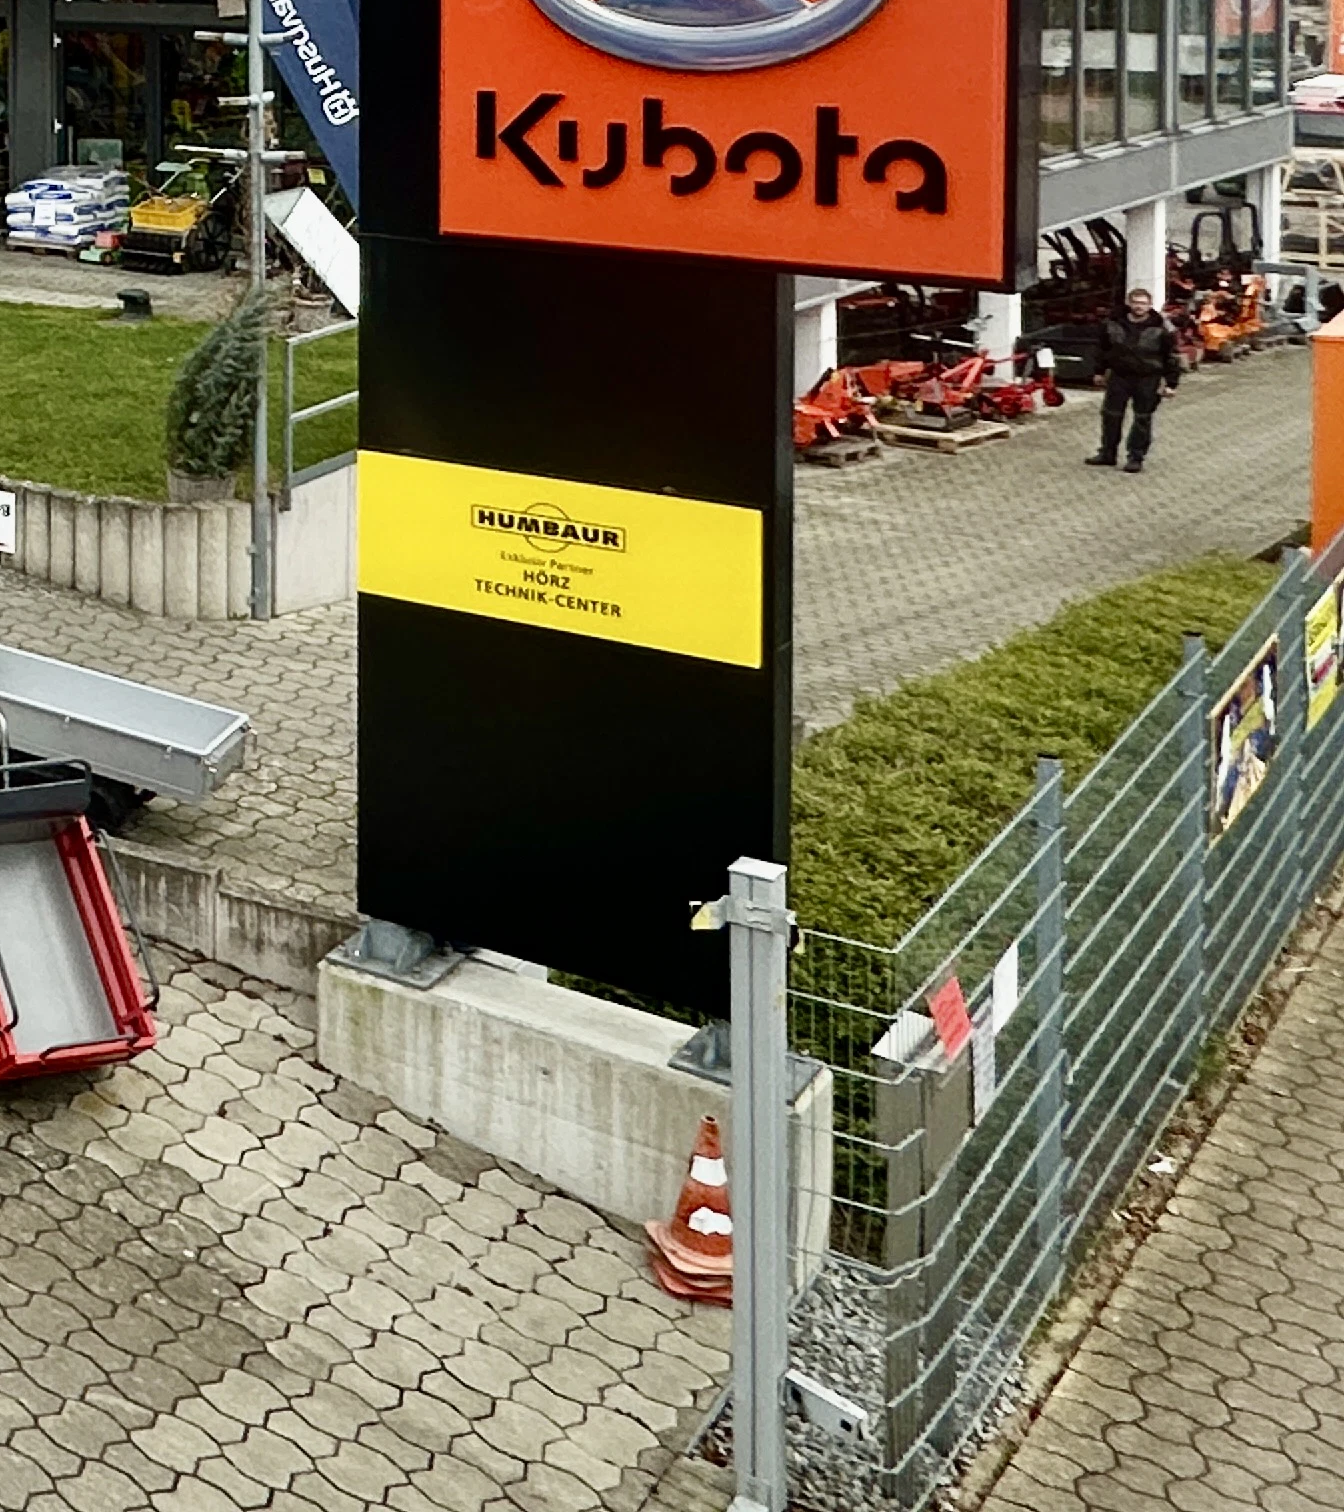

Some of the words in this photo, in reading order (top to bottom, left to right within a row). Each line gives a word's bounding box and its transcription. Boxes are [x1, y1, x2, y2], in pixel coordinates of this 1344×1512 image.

[476, 89, 948, 216] Kubota
[476, 508, 621, 549] HUMBAUR
[474, 578, 622, 619] TECHNIK-CENTER
[522, 569, 571, 591] HÖRZ
